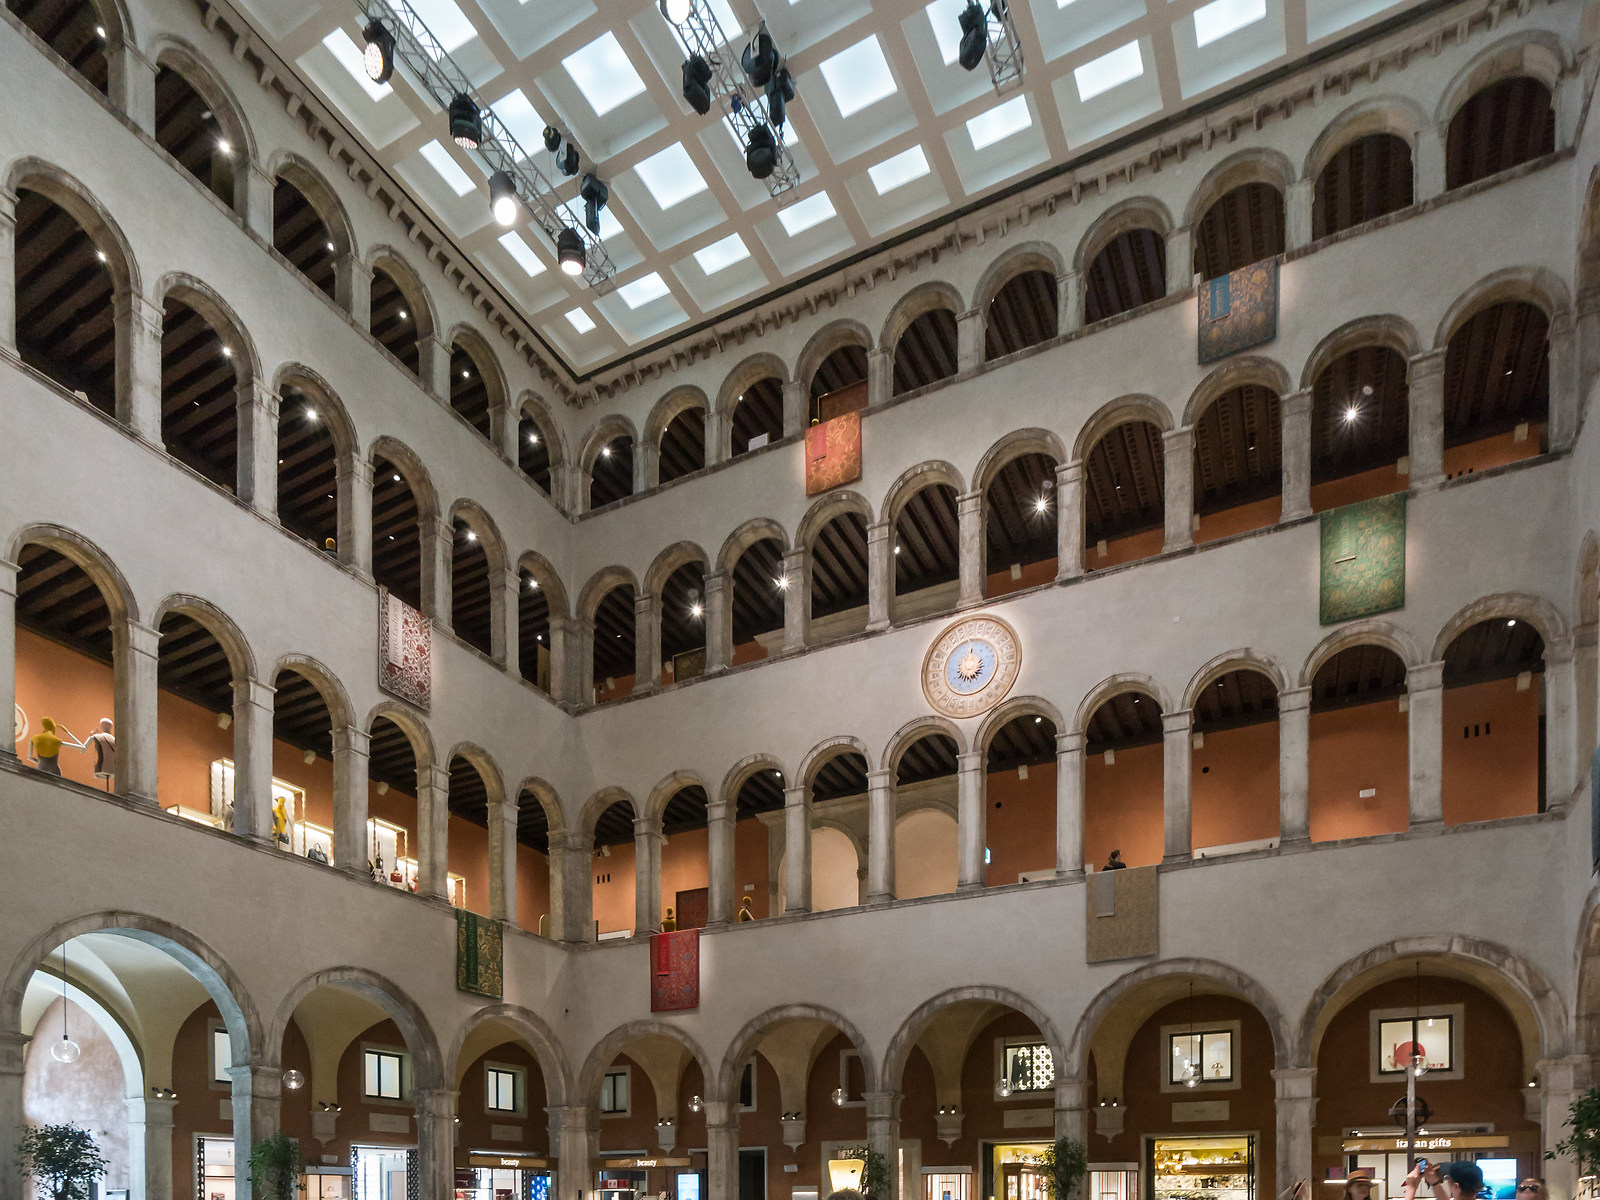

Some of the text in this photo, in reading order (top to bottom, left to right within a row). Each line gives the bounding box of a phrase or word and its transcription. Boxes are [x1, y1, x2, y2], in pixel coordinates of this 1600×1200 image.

[392, 603, 400, 637] fashion
[1396, 1138, 1451, 1149] itaan gifts
[501, 1158, 520, 1167] beauty
[637, 1159, 657, 1167] beauty
